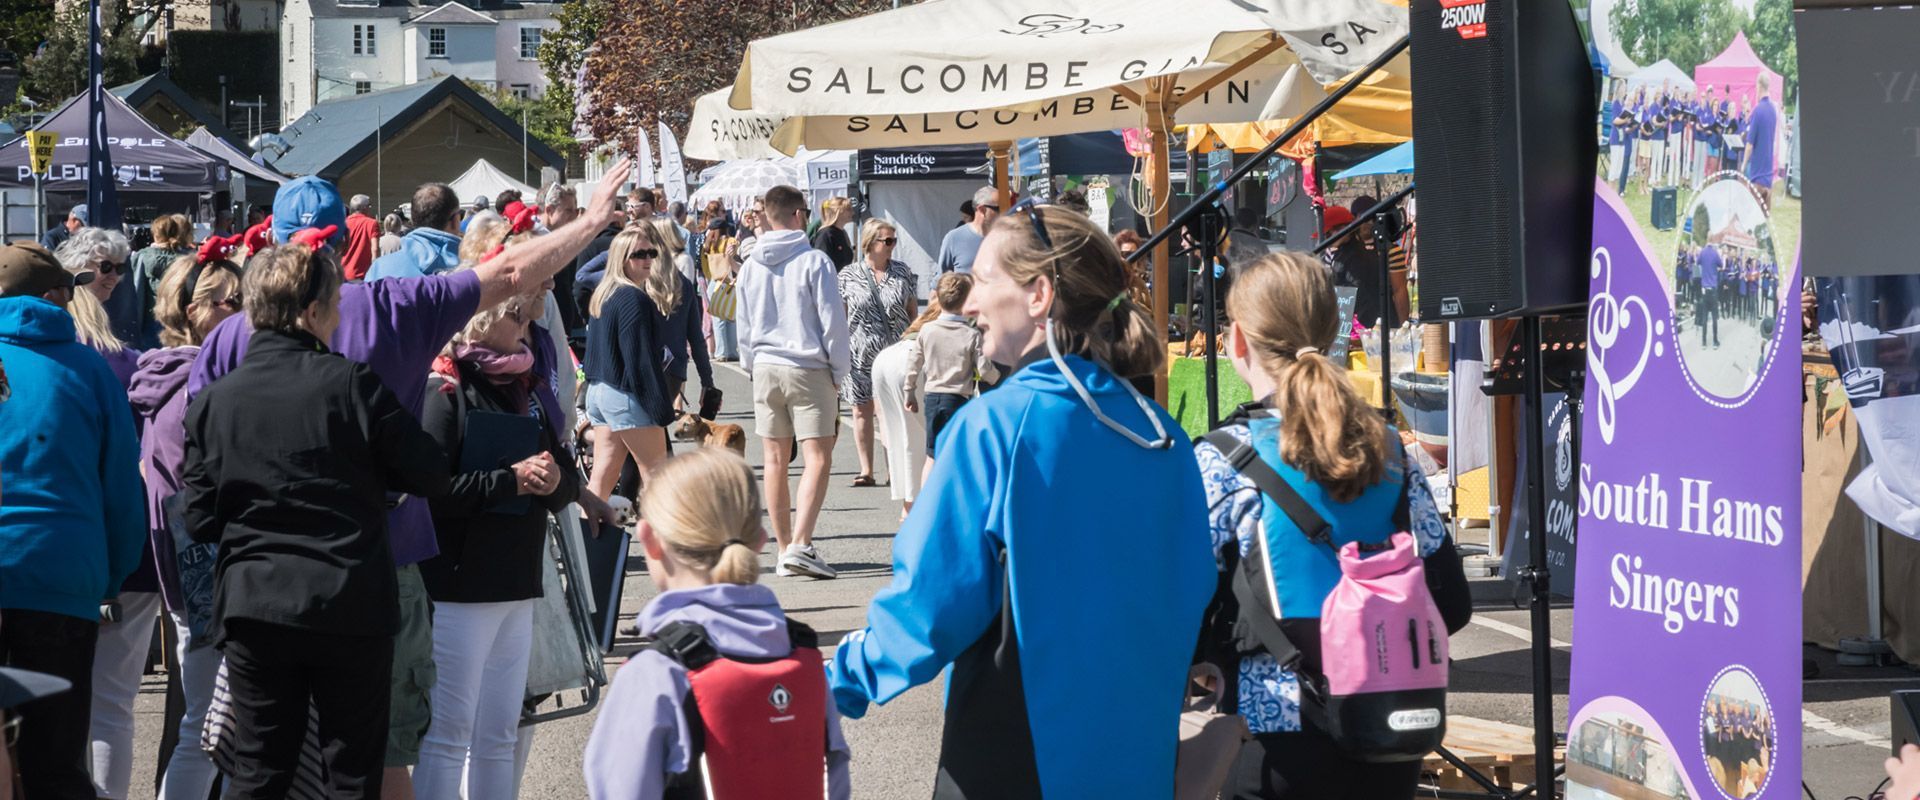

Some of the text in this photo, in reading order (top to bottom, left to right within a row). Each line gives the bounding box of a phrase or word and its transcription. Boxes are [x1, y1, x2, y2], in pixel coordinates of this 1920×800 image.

[1441, 3, 1486, 29] 2500W
[787, 56, 1197, 94] SALCOMBE GI
[36, 147, 53, 156] HERE
[39, 135, 52, 144] PAY
[873, 164, 915, 175] Barton
[1578, 462, 1784, 547] South Hams
[1610, 553, 1740, 634] Singers
